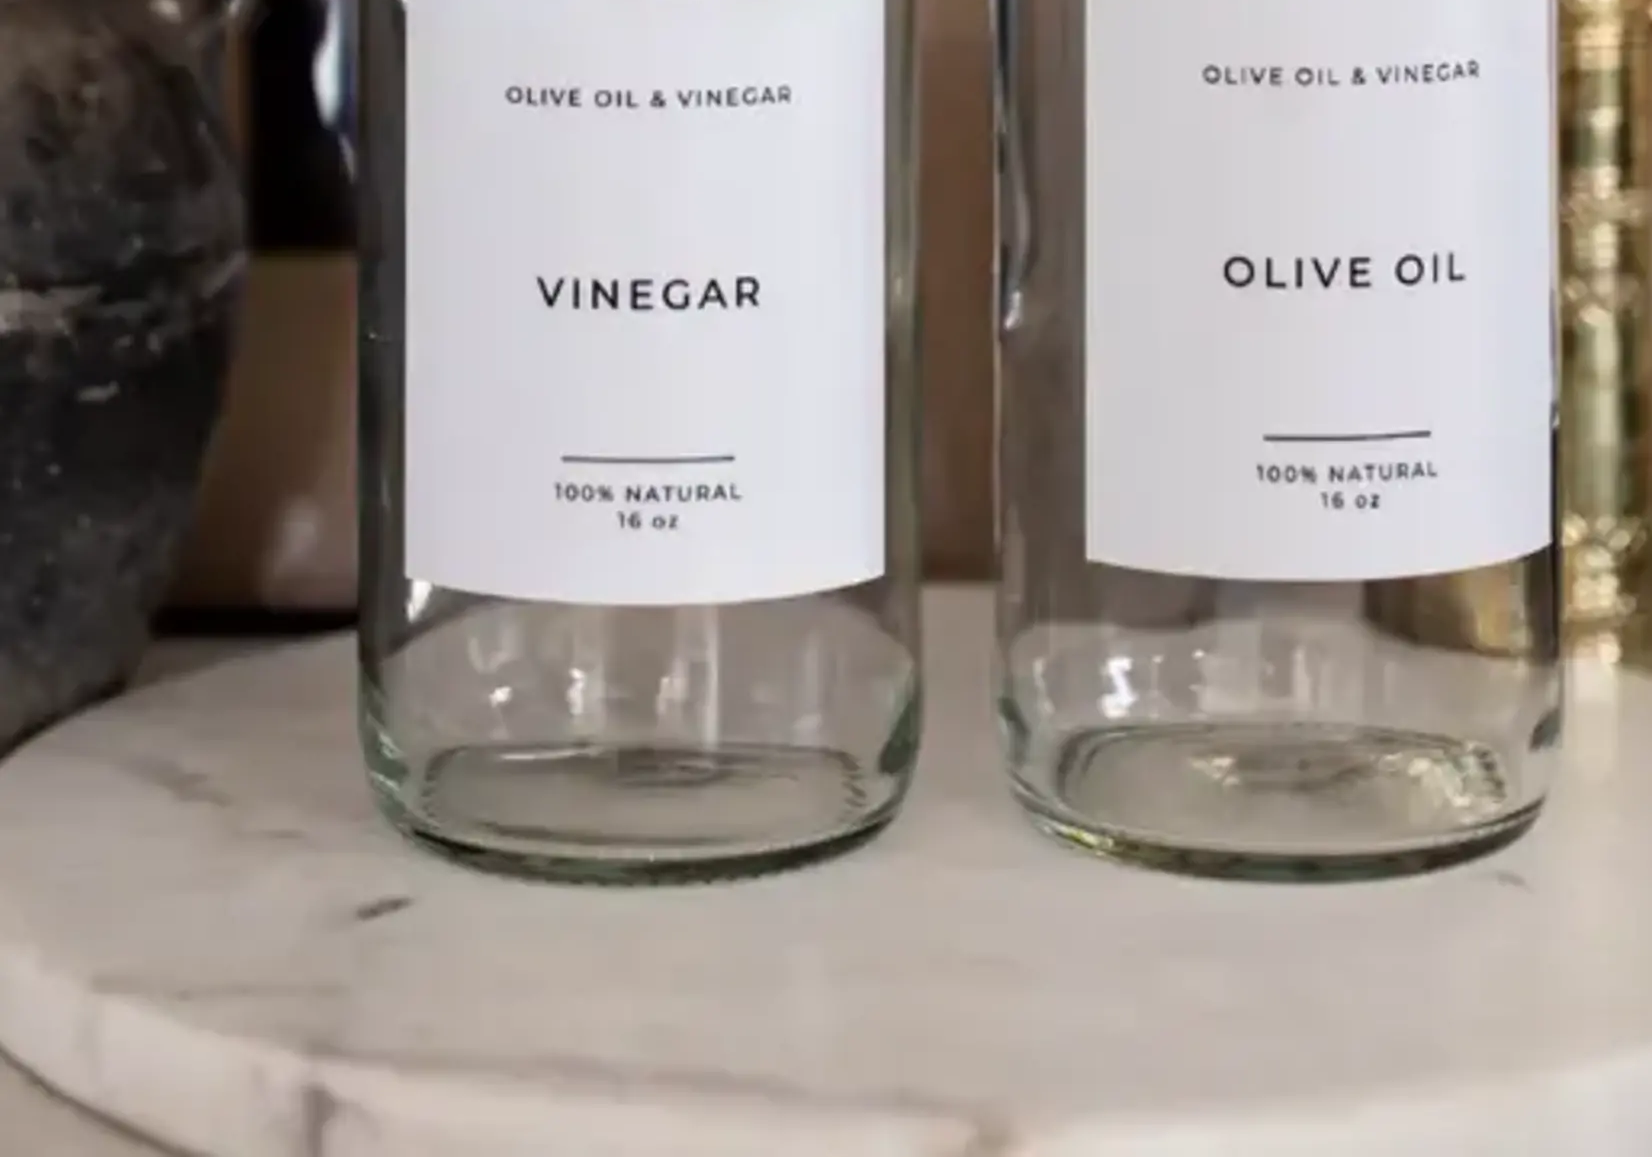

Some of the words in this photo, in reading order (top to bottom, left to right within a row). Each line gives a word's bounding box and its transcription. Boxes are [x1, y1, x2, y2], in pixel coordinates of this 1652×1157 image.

[1202, 64, 1283, 86] OLIVE
[1294, 66, 1341, 87] OIL
[1351, 67, 1367, 85] &
[1376, 60, 1481, 85] VINEGAR
[505, 86, 582, 108] OLIVE
[594, 90, 639, 109] OIL
[649, 90, 667, 108] &
[677, 85, 792, 107] VINEGAR
[1222, 255, 1373, 290] OLIVE
[1394, 251, 1467, 287] OIL
[536, 275, 762, 312] VINEGAR
[1256, 463, 1318, 484] 100%
[1328, 461, 1438, 483] NATURAL
[554, 482, 614, 502] 100%
[625, 483, 742, 503] NATURAL
[1321, 491, 1345, 510] 16
[1355, 493, 1380, 510] oz
[617, 511, 642, 529] 16
[651, 515, 679, 529] oz
